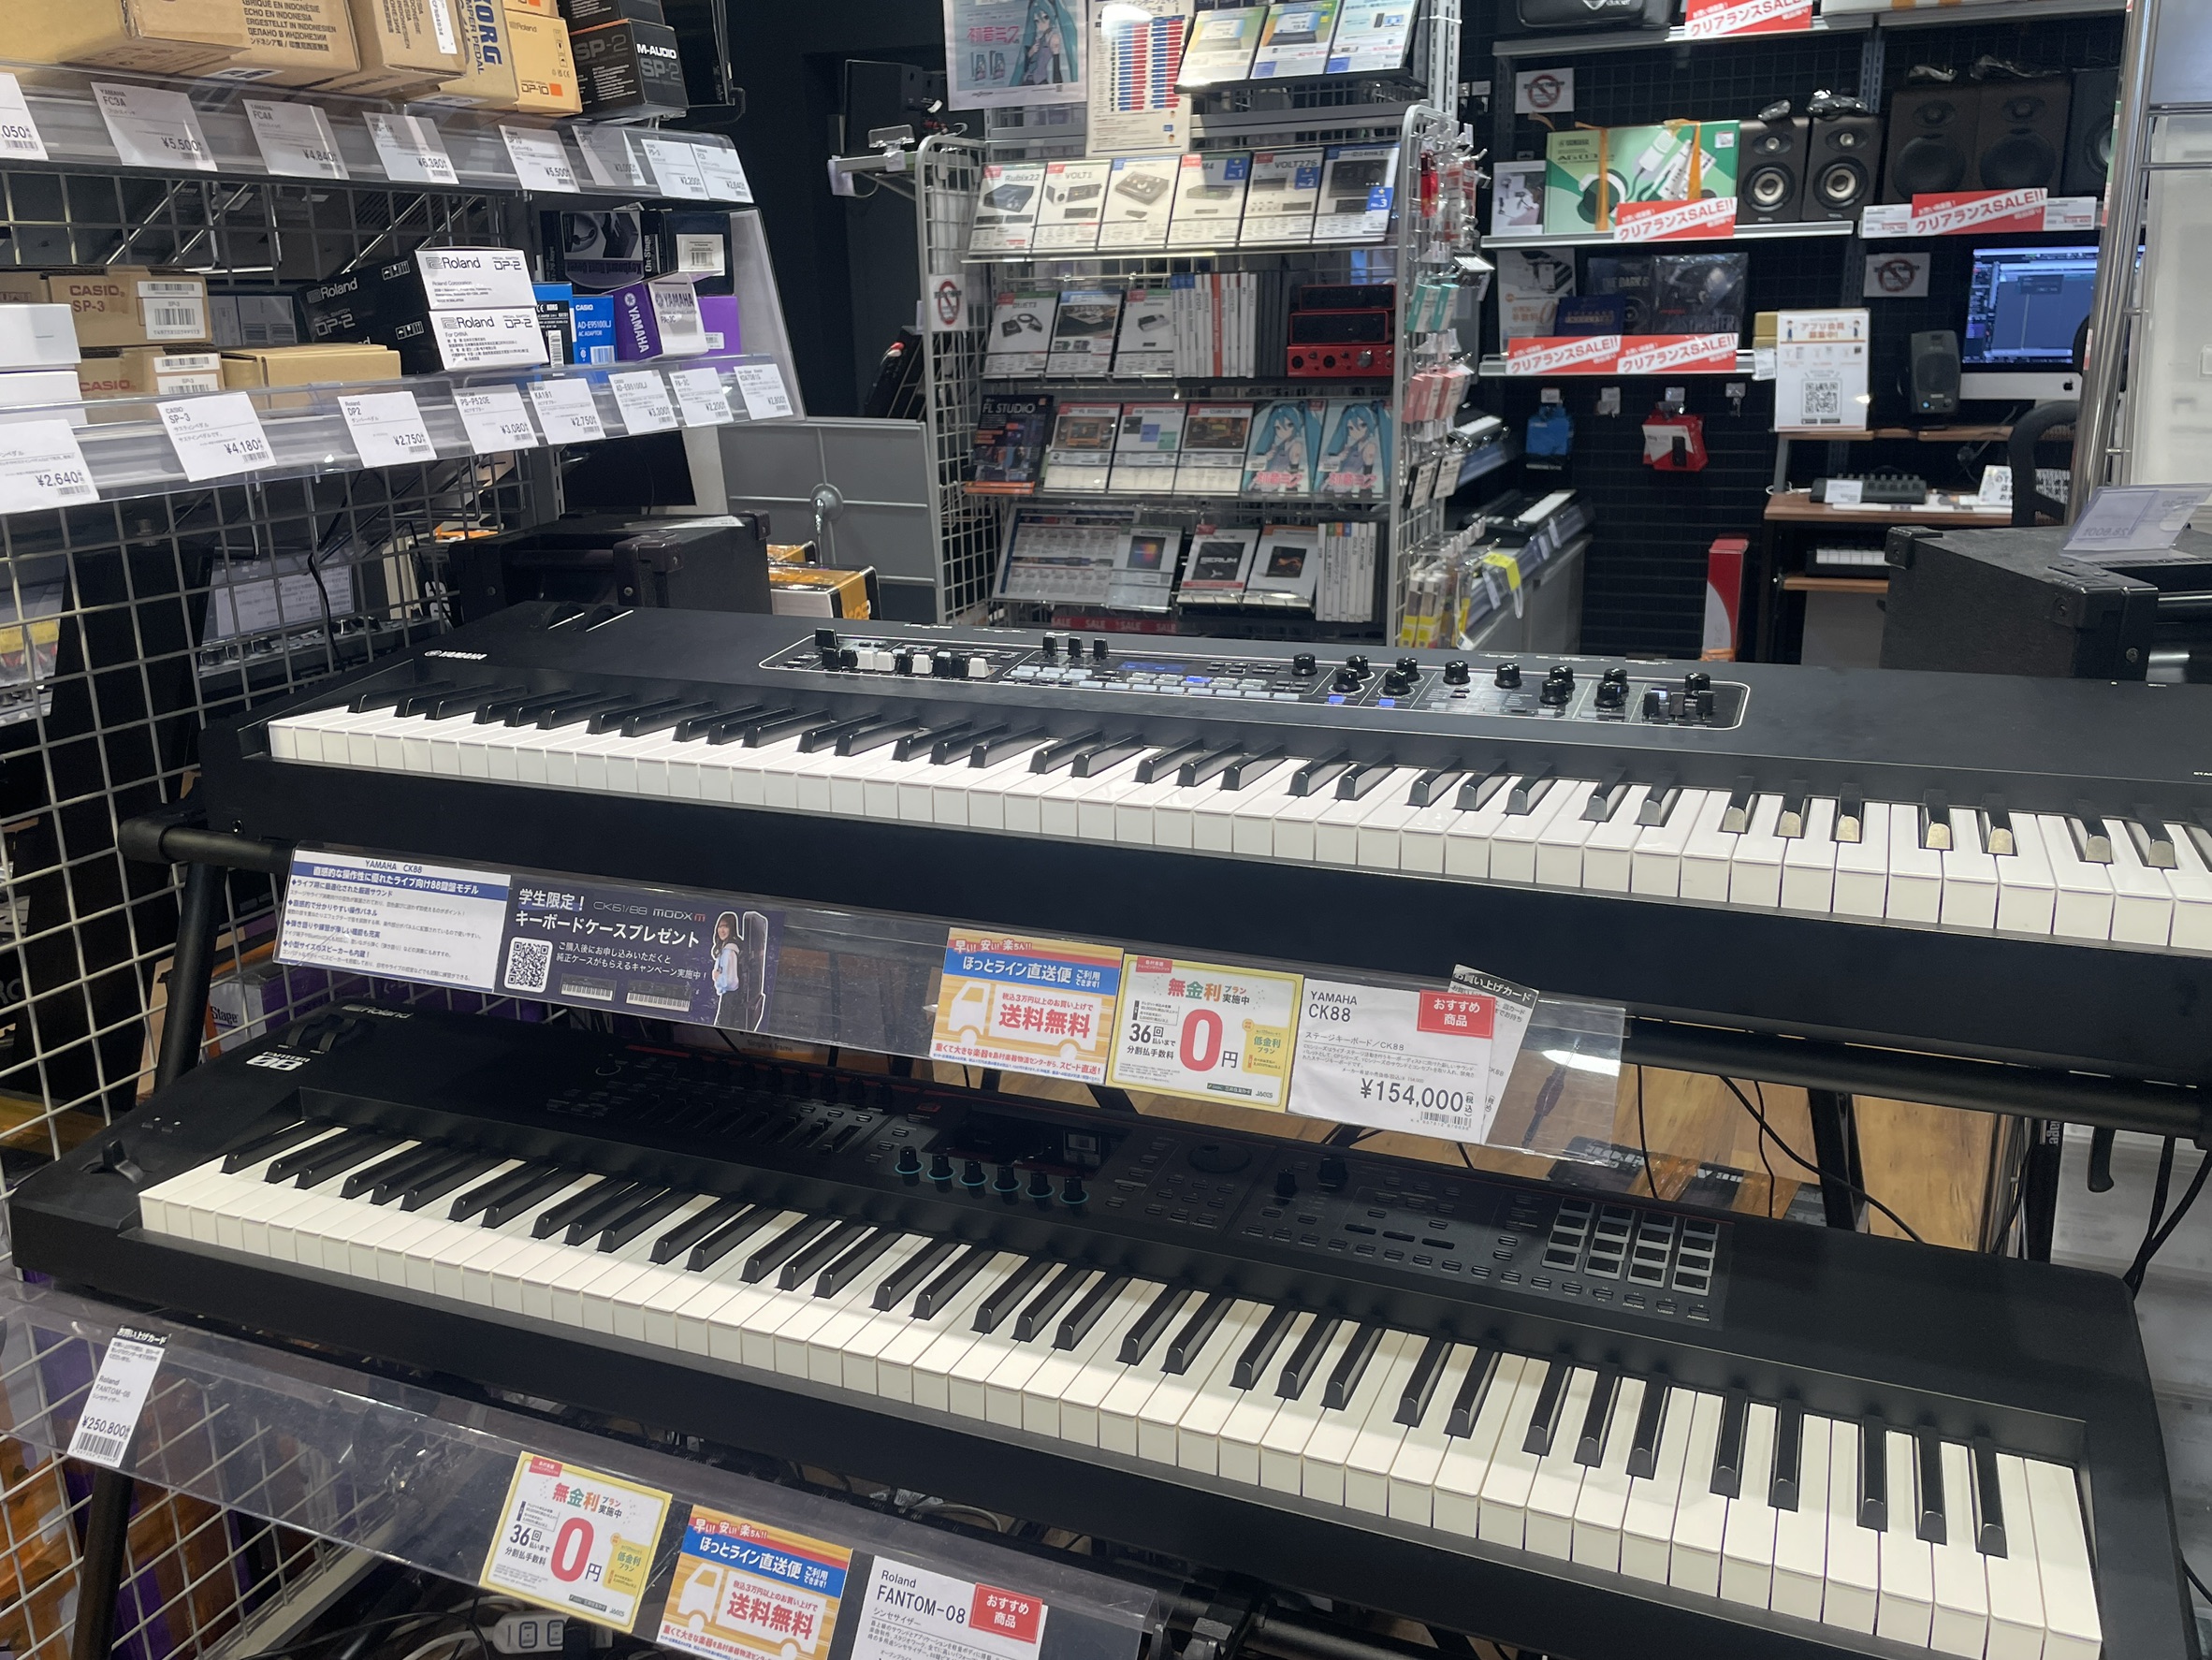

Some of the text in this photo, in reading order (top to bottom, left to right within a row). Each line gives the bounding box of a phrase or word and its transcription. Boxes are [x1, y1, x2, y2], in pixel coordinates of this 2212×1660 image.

[276, 11, 313, 22] INDONESIA
[298, 23, 336, 33] INDONESIEN
[517, 22, 538, 34] Roland
[968, 26, 1020, 44] 初音ミク
[574, 34, 627, 61] SP-2
[636, 43, 677, 59] M-AUDIO
[473, 36, 485, 75] PEDAL
[640, 58, 681, 81] SP-2
[521, 81, 549, 95] DP-10
[104, 95, 126, 108] FC3A
[1005, 173, 1040, 182] Rubix22
[442, 255, 481, 269] Roland
[493, 260, 522, 270] DP-2
[70, 285, 120, 297] CASIO
[321, 278, 358, 299] Roland
[72, 300, 106, 313] SP-3
[662, 292, 695, 308] YAMAHA
[457, 315, 495, 328] Roland
[504, 318, 533, 328] DP-2
[626, 305, 650, 354] YAMAHA
[80, 379, 130, 392] CASIO
[533, 391, 552, 400] KA181
[165, 406, 183, 415] CASIO
[347, 407, 362, 416] DP2
[983, 403, 1036, 414] FL STUDIO
[168, 413, 191, 424] SP-3
[224, 439, 258, 455] ¥4,180
[393, 433, 422, 446] ¥2,750
[35, 471, 79, 488] ¥2,640
[1053, 618, 1070, 627] SALE
[1085, 619, 1105, 629] SALE
[1121, 620, 1142, 631] SALE
[365, 860, 423, 874] YAMAHA CK88
[518, 889, 585, 911] 学生限定!
[593, 901, 648, 915] CK61/88
[516, 910, 700, 949] キーボードケースプレゼント
[559, 941, 672, 965] ご購入後にお申し込みいただくと
[954, 940, 977, 953] 早い!
[981, 939, 999, 951] 安い!
[556, 953, 707, 981] 純正ケースがもらえるキャンペーン実施中!
[963, 955, 1073, 983] ほっとライン直送便
[1076, 969, 1100, 981] ご利用
[1075, 978, 1100, 989] できます!
[1168, 978, 1222, 1002] 無金利
[1224, 985, 1246, 995] プラン
[1222, 994, 1250, 1005] 実施中
[1311, 991, 1358, 1006] YAMAHA
[1433, 997, 1480, 1013] おすすめ
[211, 1006, 239, 1024] Stage
[359, 1006, 414, 1019] Roland
[1309, 1003, 1351, 1023] CK88
[998, 1003, 1091, 1039] 送料無料
[1444, 1014, 1468, 1027] 商品
[1129, 1023, 1164, 1043] 36 回
[1180, 1009, 1223, 1072] 0
[1221, 1050, 1239, 1069] 円
[1152, 1037, 1176, 1047] 払いまで
[1254, 1036, 1281, 1049] 低金利
[1127, 1045, 1174, 1060] 分割払手数料
[1361, 1077, 1463, 1113] ¥154,000
[98, 1376, 120, 1385] Roland
[82, 1416, 125, 1437] ¥250,800
[552, 1483, 600, 1512] 無金利
[603, 1495, 620, 1507] プラン
[598, 1505, 622, 1519] 実施中
[693, 1518, 716, 1534] 早い!
[720, 1522, 737, 1535] 安い!
[510, 1523, 543, 1547] 36 回
[529, 1540, 550, 1553] 払いまで
[550, 1517, 602, 1582] 0 円
[505, 1547, 546, 1566] 分割払手数料
[617, 1551, 642, 1566] 低金利
[700, 1536, 802, 1580] ほっとライン直送便
[806, 1565, 829, 1581] ご利用
[880, 1569, 917, 1589] Roland
[804, 1575, 826, 1589] できます!
[877, 1584, 966, 1624] FANTOM-08
[986, 1594, 1029, 1615] おすすめ
[727, 1591, 815, 1640] 送料無料
[874, 1607, 921, 1627] シンセサイザー
[994, 1611, 1016, 1629] 商品
